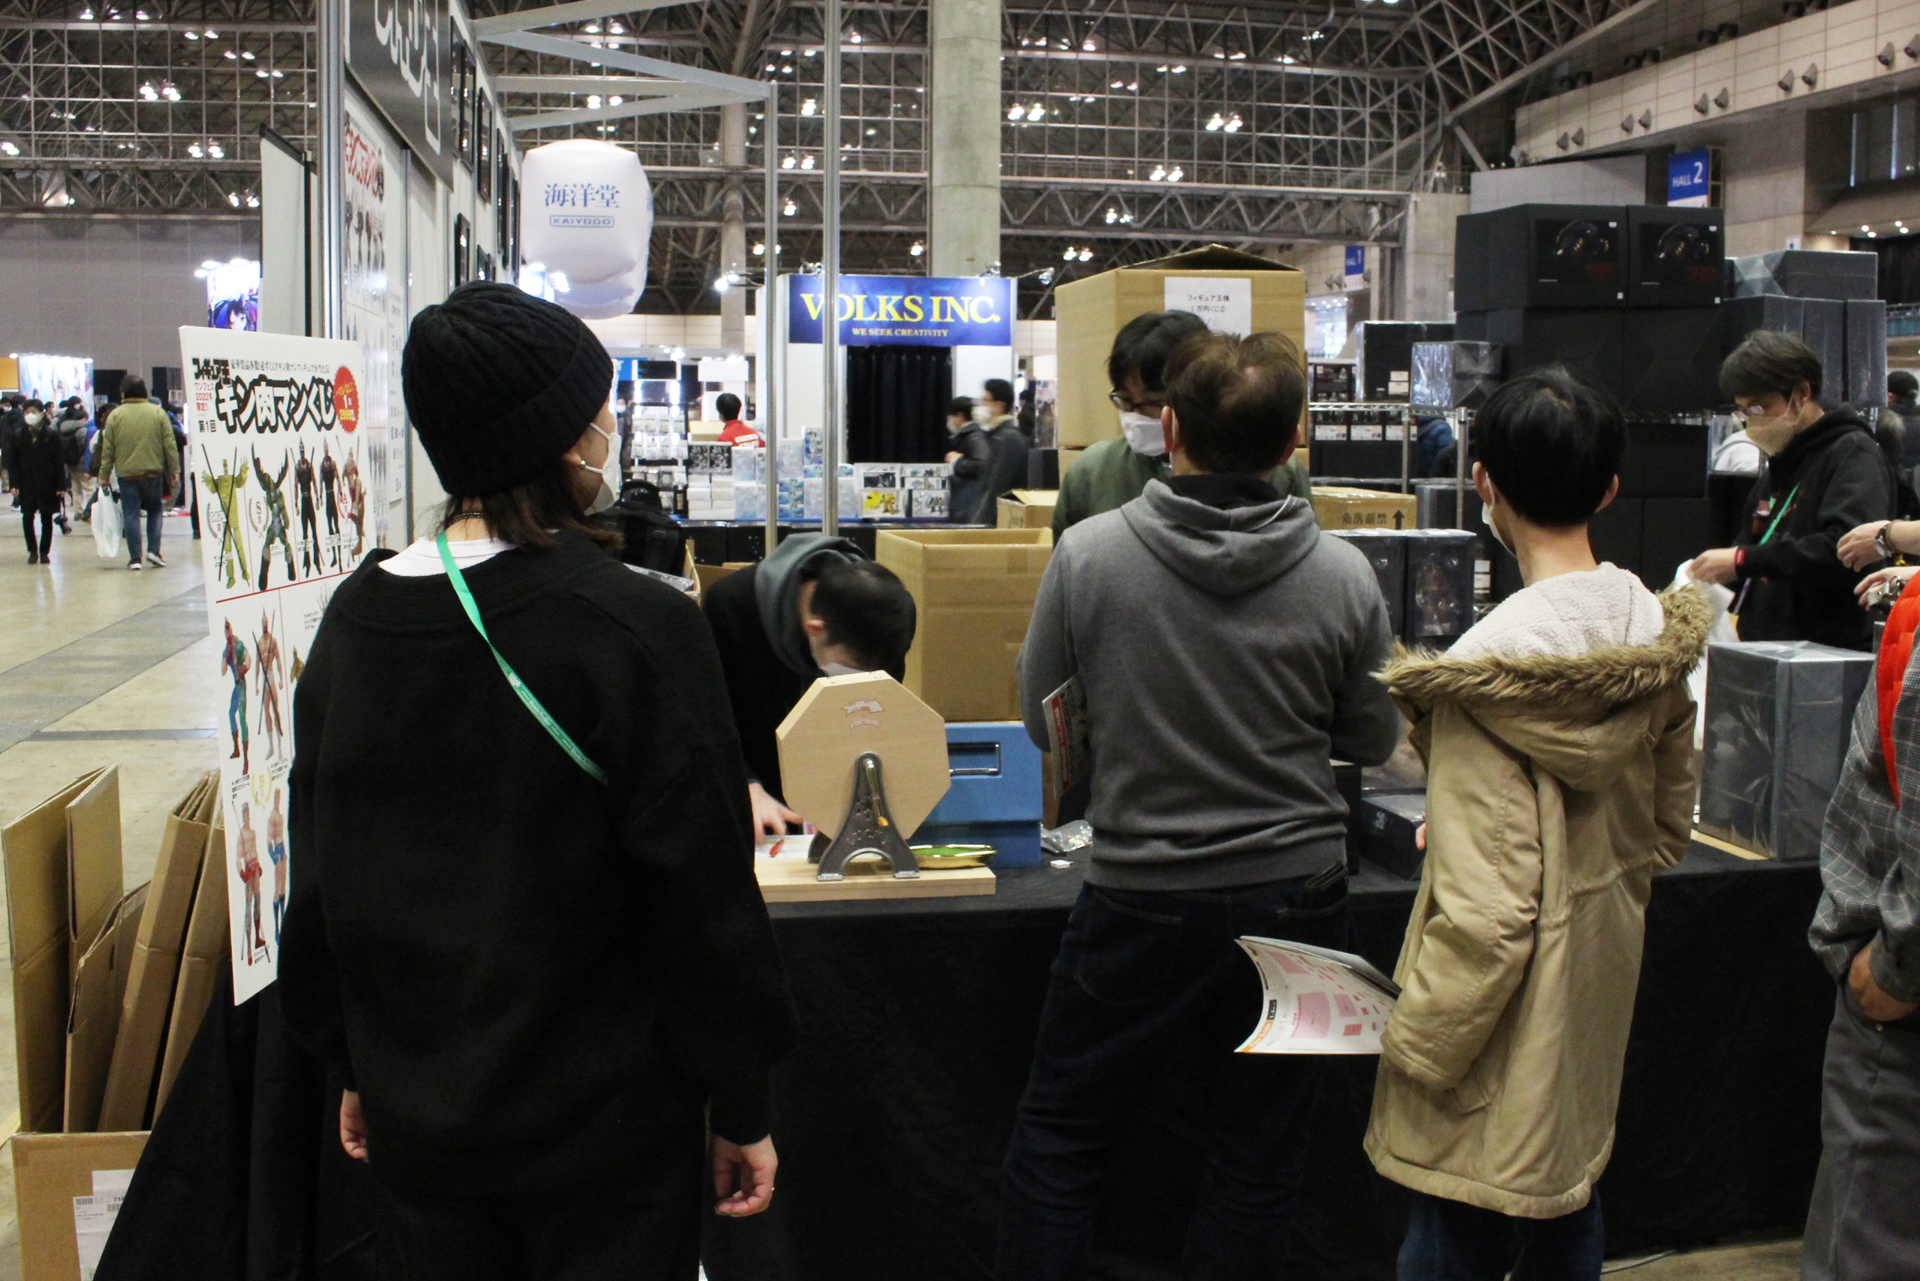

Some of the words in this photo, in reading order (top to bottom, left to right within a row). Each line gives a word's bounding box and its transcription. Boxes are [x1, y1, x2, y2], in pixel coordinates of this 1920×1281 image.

[1672, 174, 1692, 187] HALL
[1693, 161, 1703, 184] 2
[544, 183, 620, 209] 海洋堂
[553, 217, 611, 226] KAIYODO
[1186, 294, 1230, 303] フィギュア王様
[800, 292, 924, 323] VOLKS
[929, 296, 1001, 324] INC.
[852, 328, 867, 337] WE
[869, 328, 894, 337] SEEK
[894, 327, 949, 338] CREATIVITY
[195, 392, 213, 402] 2022冬
[216, 374, 337, 434] キン肉マンくじ
[198, 420, 216, 433] 第1回
